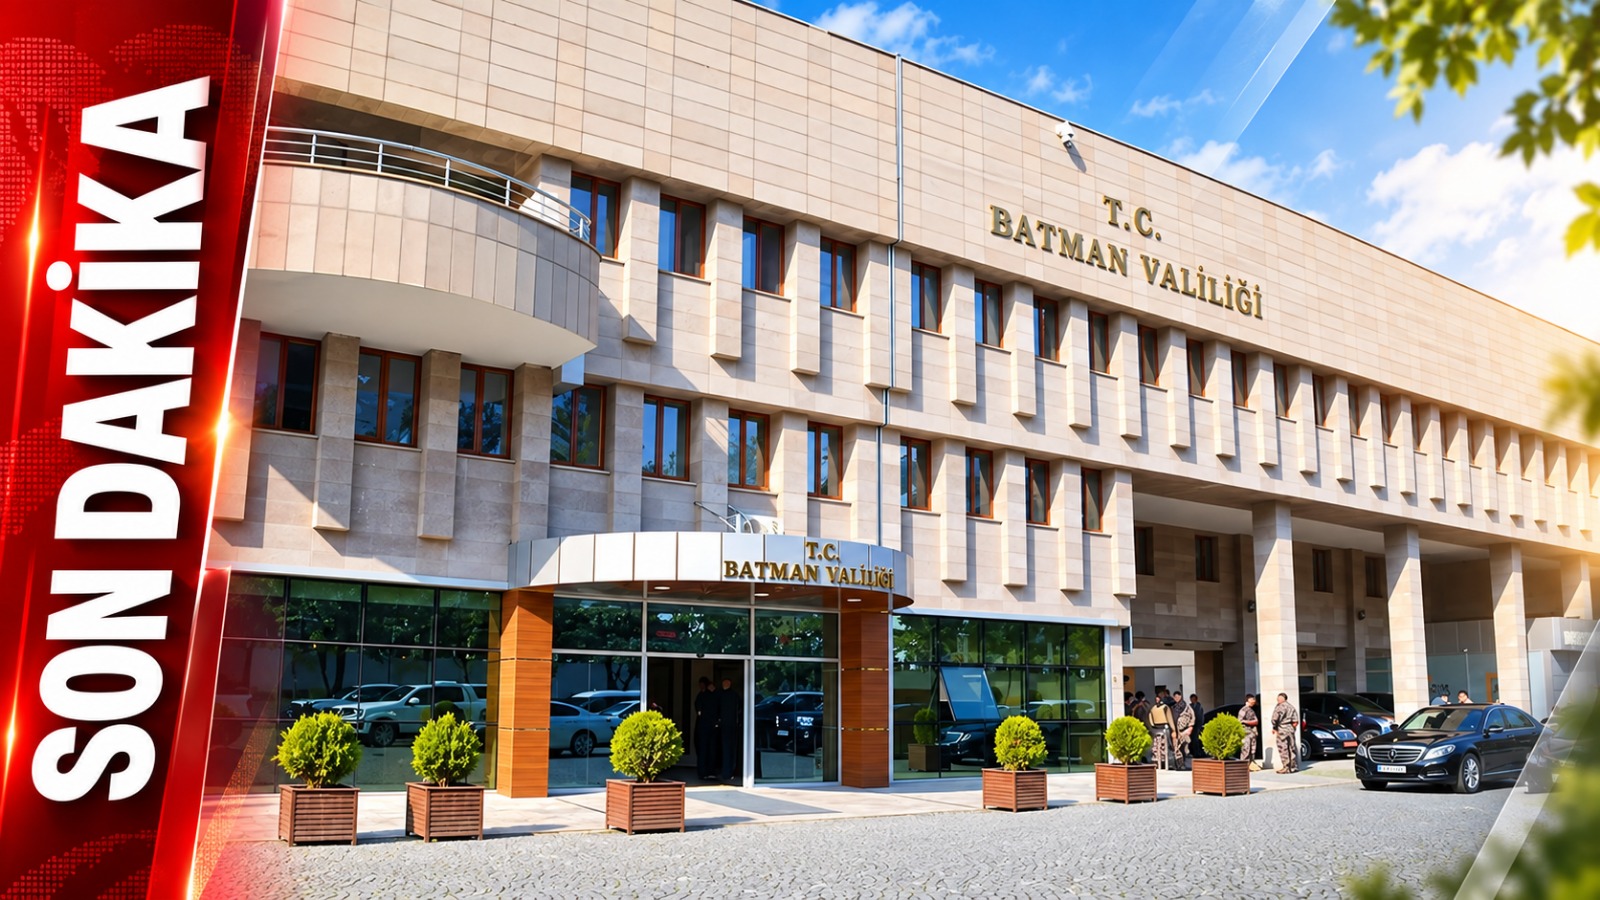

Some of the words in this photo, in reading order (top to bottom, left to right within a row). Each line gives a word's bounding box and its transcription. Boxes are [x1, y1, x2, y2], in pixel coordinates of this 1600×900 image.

[1103, 194, 1162, 241] T.C.
[989, 204, 1128, 277] BATMAN
[1140, 254, 1263, 319] VALİLİĞİ
[805, 541, 840, 562] T.C.
[723, 560, 820, 583] BATMAN
